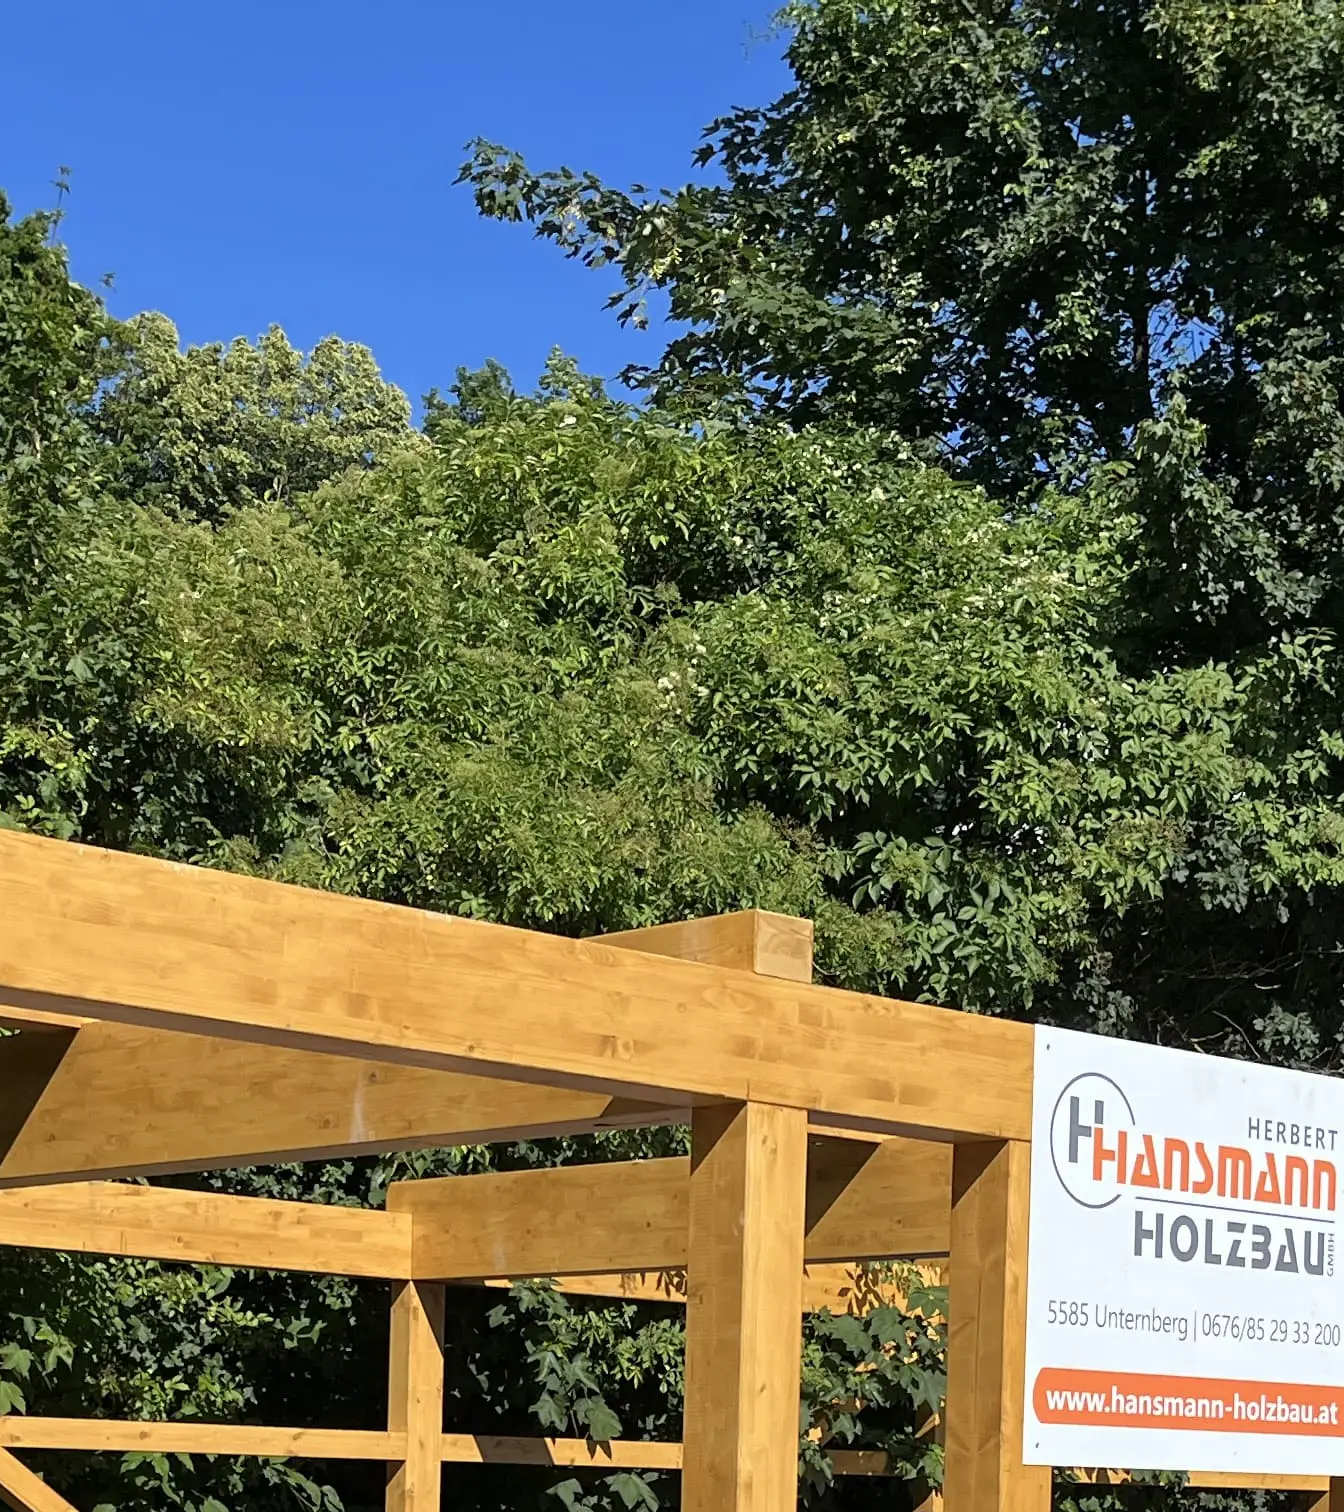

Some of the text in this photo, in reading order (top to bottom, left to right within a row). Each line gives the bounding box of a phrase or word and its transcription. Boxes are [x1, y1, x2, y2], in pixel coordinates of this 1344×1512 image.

[1248, 1116, 1337, 1151] HERBERT
[1092, 1127, 1336, 1211] HANSMANN
[1134, 1210, 1324, 1276] HOLZBAU
[1047, 1300, 1340, 1347] 5585 Unternberg 0676/85 29 33 200
[1046, 1387, 1338, 1425] www.hansmann-holzbau.at
